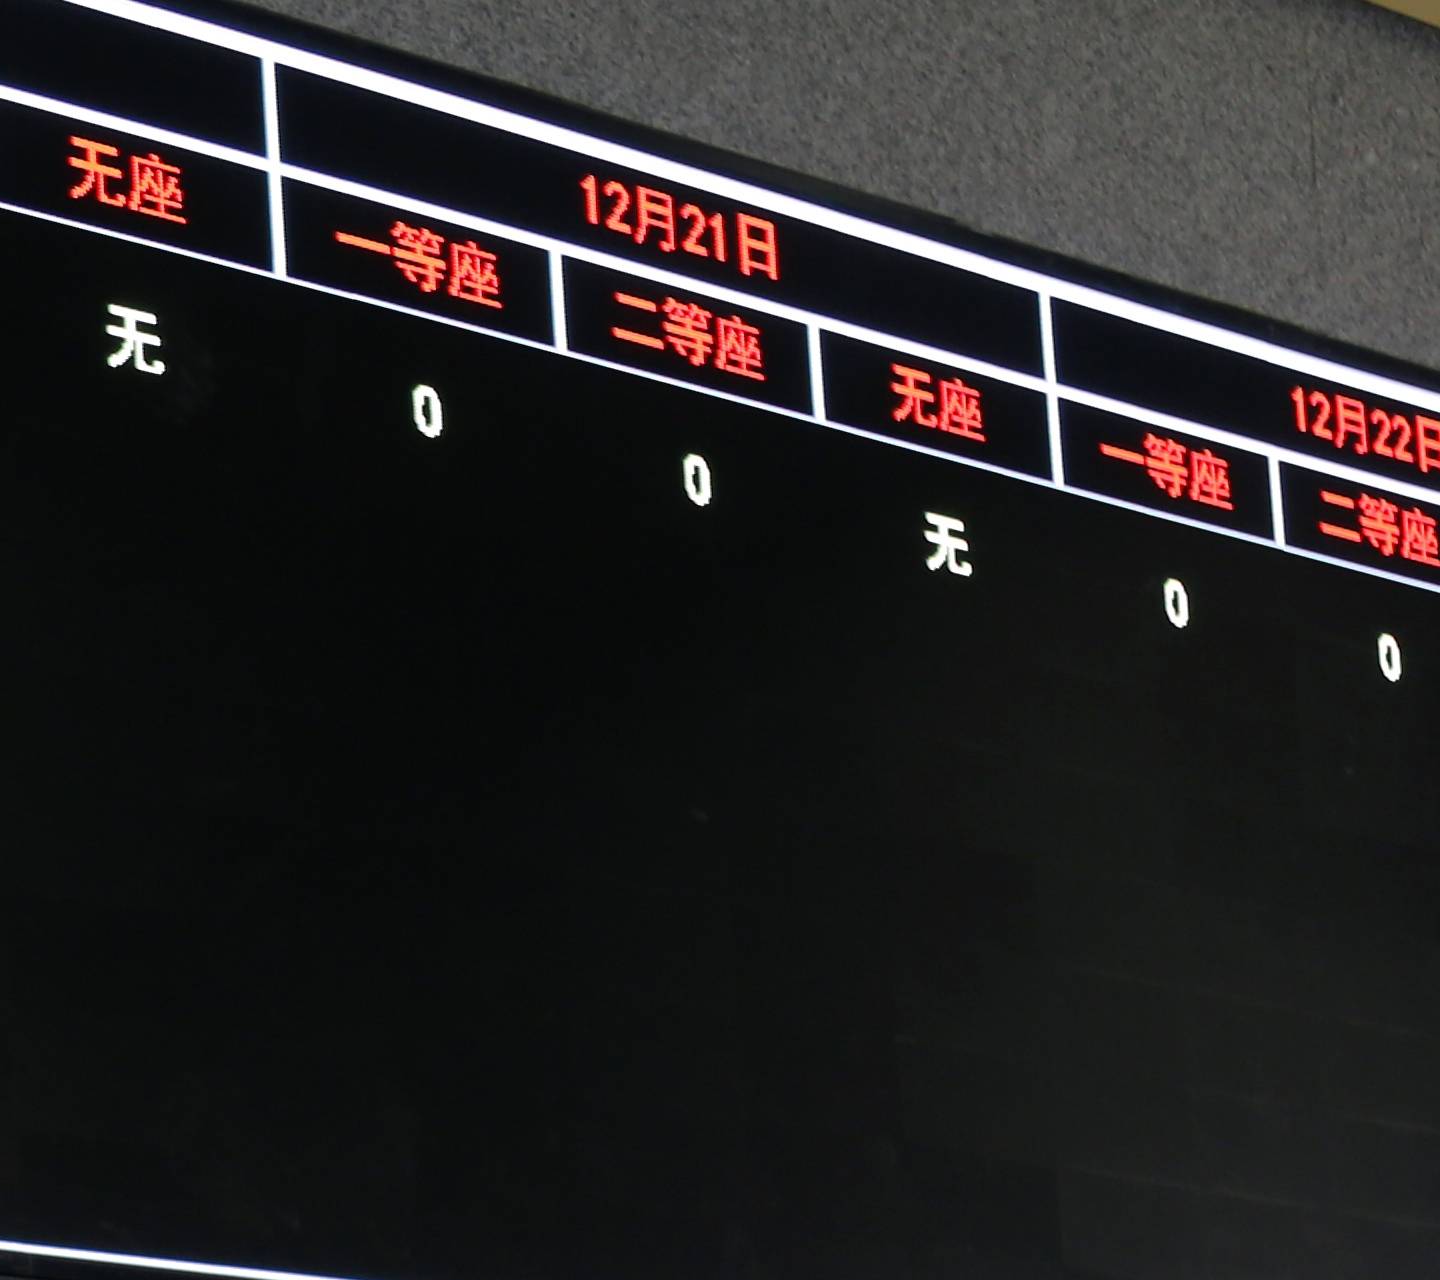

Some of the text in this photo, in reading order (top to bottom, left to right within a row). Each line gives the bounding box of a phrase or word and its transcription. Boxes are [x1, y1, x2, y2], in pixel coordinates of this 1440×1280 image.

[68, 136, 186, 224] 无座
[580, 175, 778, 280] 12月21日
[336, 221, 502, 308] 一等座
[107, 304, 165, 374] 无
[612, 292, 765, 380] 二等座
[413, 385, 442, 438] 0
[891, 364, 985, 442] 无座
[684, 454, 711, 506] 0
[1100, 433, 1233, 510] 一等座
[925, 512, 972, 576] 无
[1164, 579, 1188, 628] 0
[1379, 634, 1401, 681] 0
